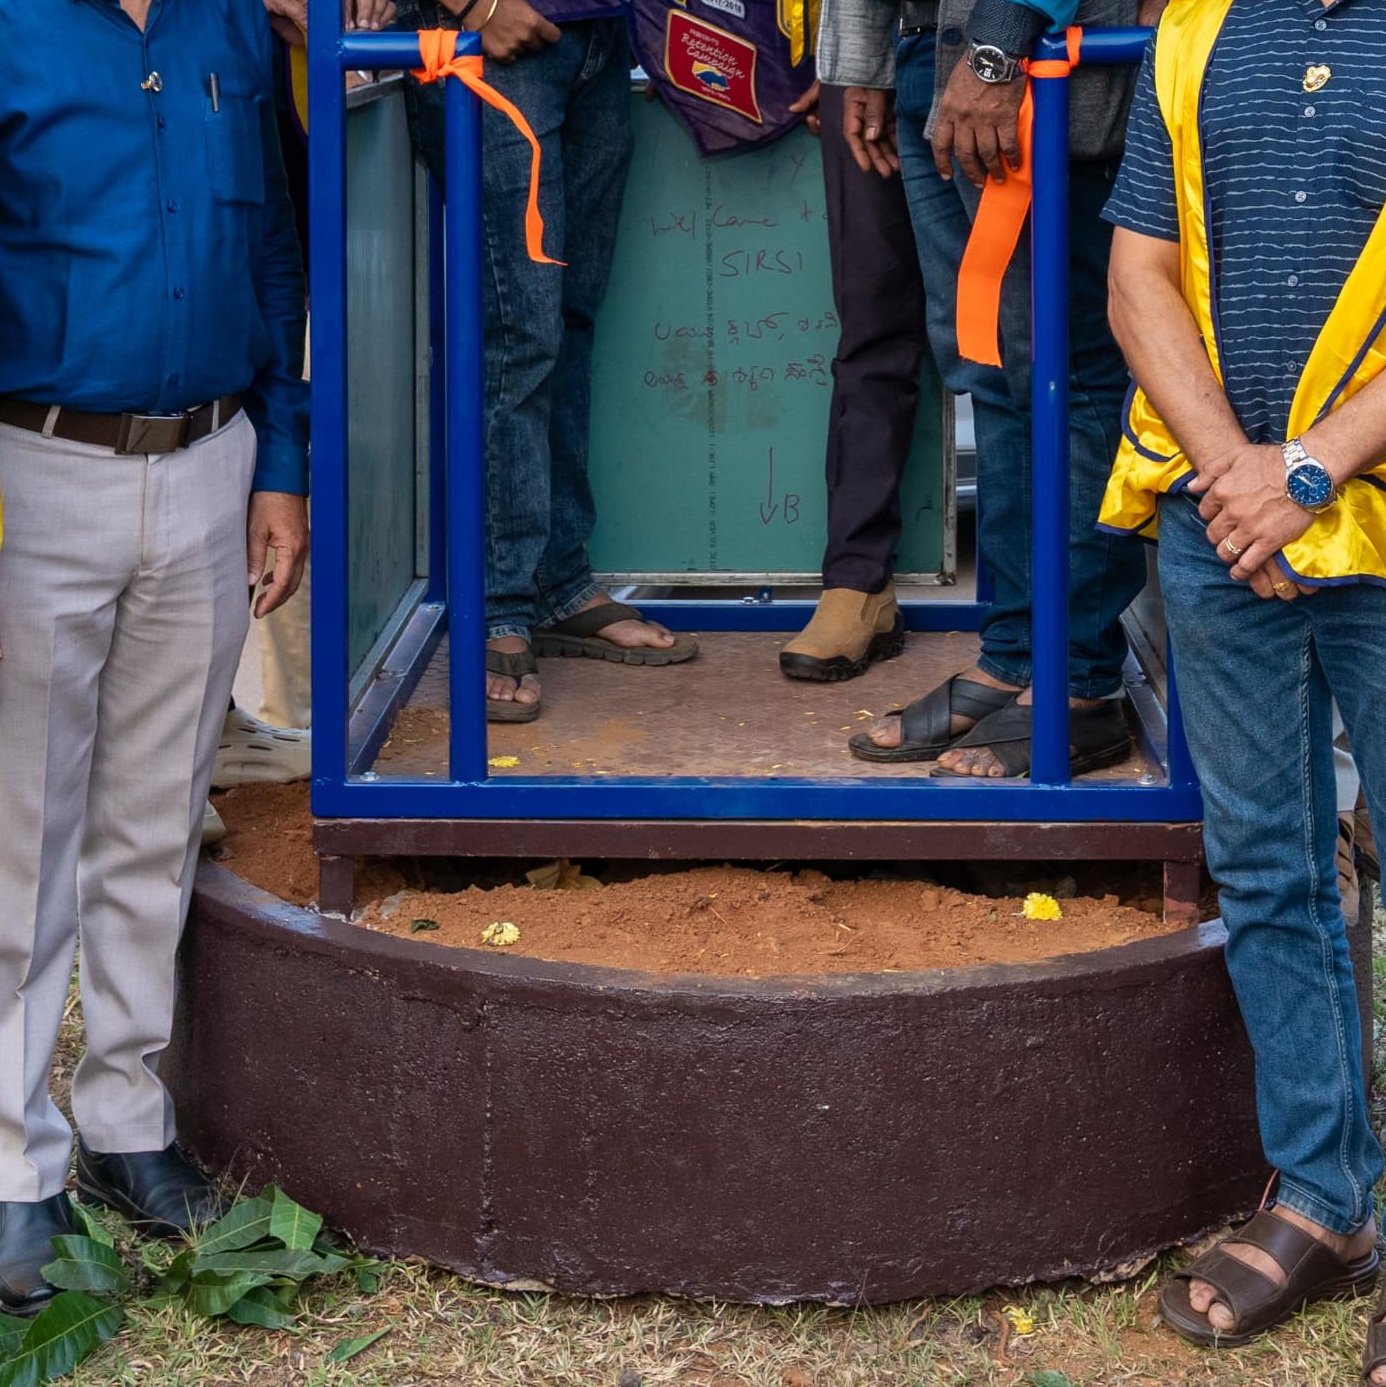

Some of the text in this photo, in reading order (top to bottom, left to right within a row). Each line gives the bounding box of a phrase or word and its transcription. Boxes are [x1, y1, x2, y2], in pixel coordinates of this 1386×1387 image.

[681, 33, 738, 65] Retention
[686, 46, 745, 79] Campaign
[719, 249, 802, 277] SIRSI
